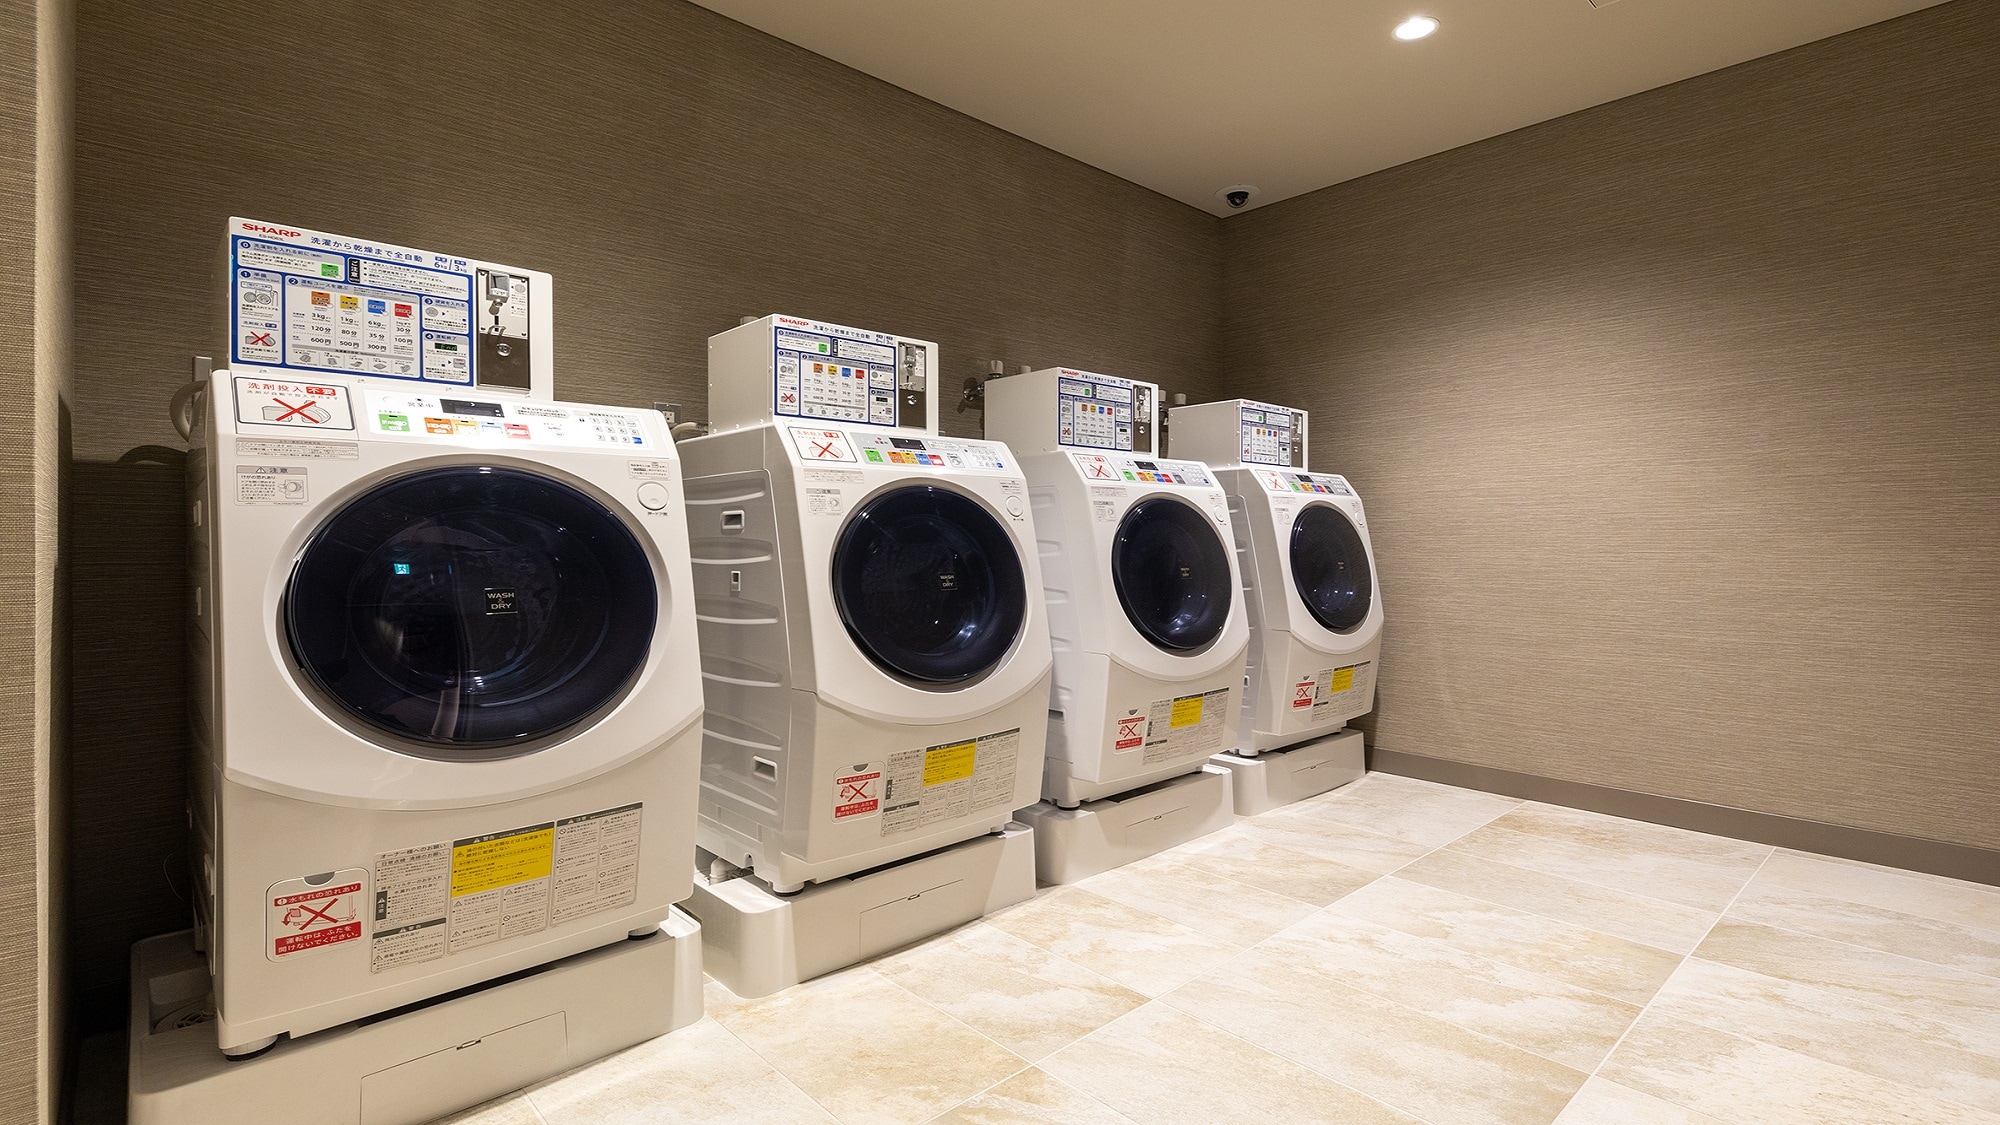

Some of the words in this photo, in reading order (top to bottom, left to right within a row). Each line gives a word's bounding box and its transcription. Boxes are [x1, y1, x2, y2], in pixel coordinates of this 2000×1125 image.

[242, 223, 301, 238] SHARP
[311, 236, 423, 263] 洗濯から乾燥まで全自動
[779, 317, 809, 326] SHARP
[248, 382, 303, 393] 洗剤投入
[381, 843, 447, 859] オーナー様へのお願い
[288, 884, 359, 904] 水もれの恐れあり
[278, 932, 359, 952] 開けないでください。
[285, 925, 352, 945] 運転中は、ふたを
